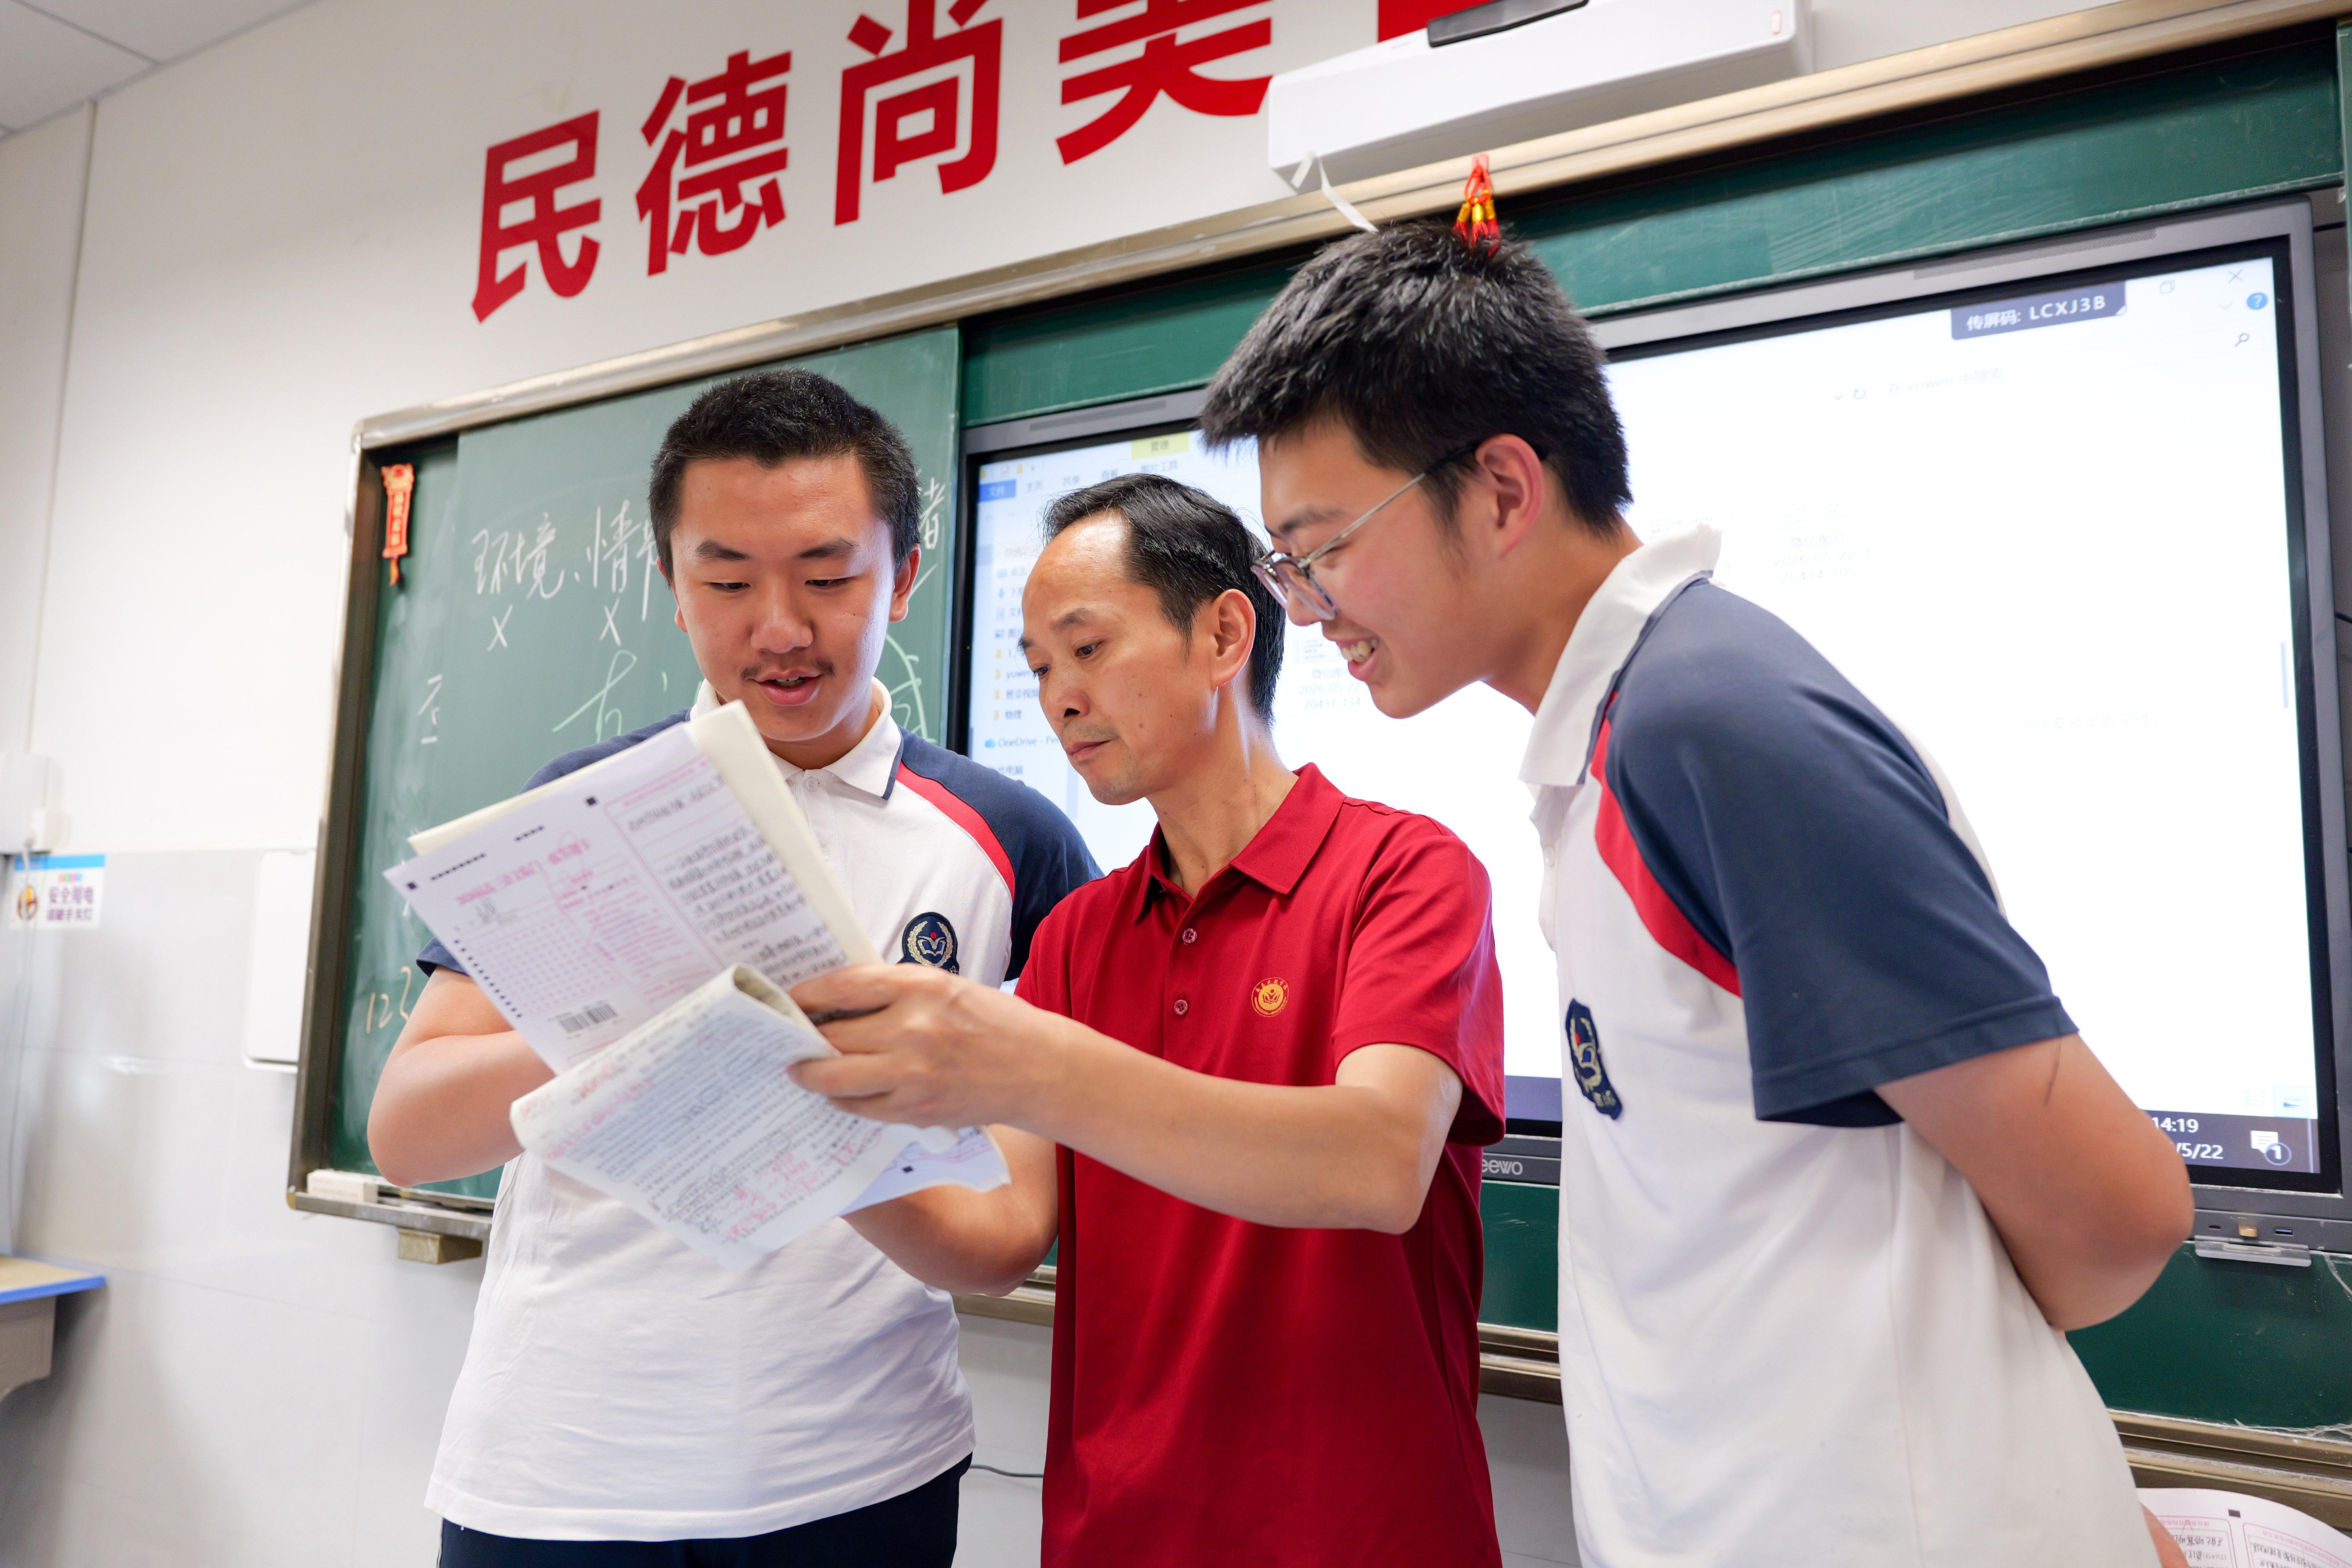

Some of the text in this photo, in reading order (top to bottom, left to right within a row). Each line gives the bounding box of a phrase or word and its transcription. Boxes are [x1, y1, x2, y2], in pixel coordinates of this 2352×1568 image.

[2029, 295, 2106, 320] LCXJ3B
[998, 737, 1038, 748] OneDrive
[2151, 1116, 2199, 1133] 14:19
